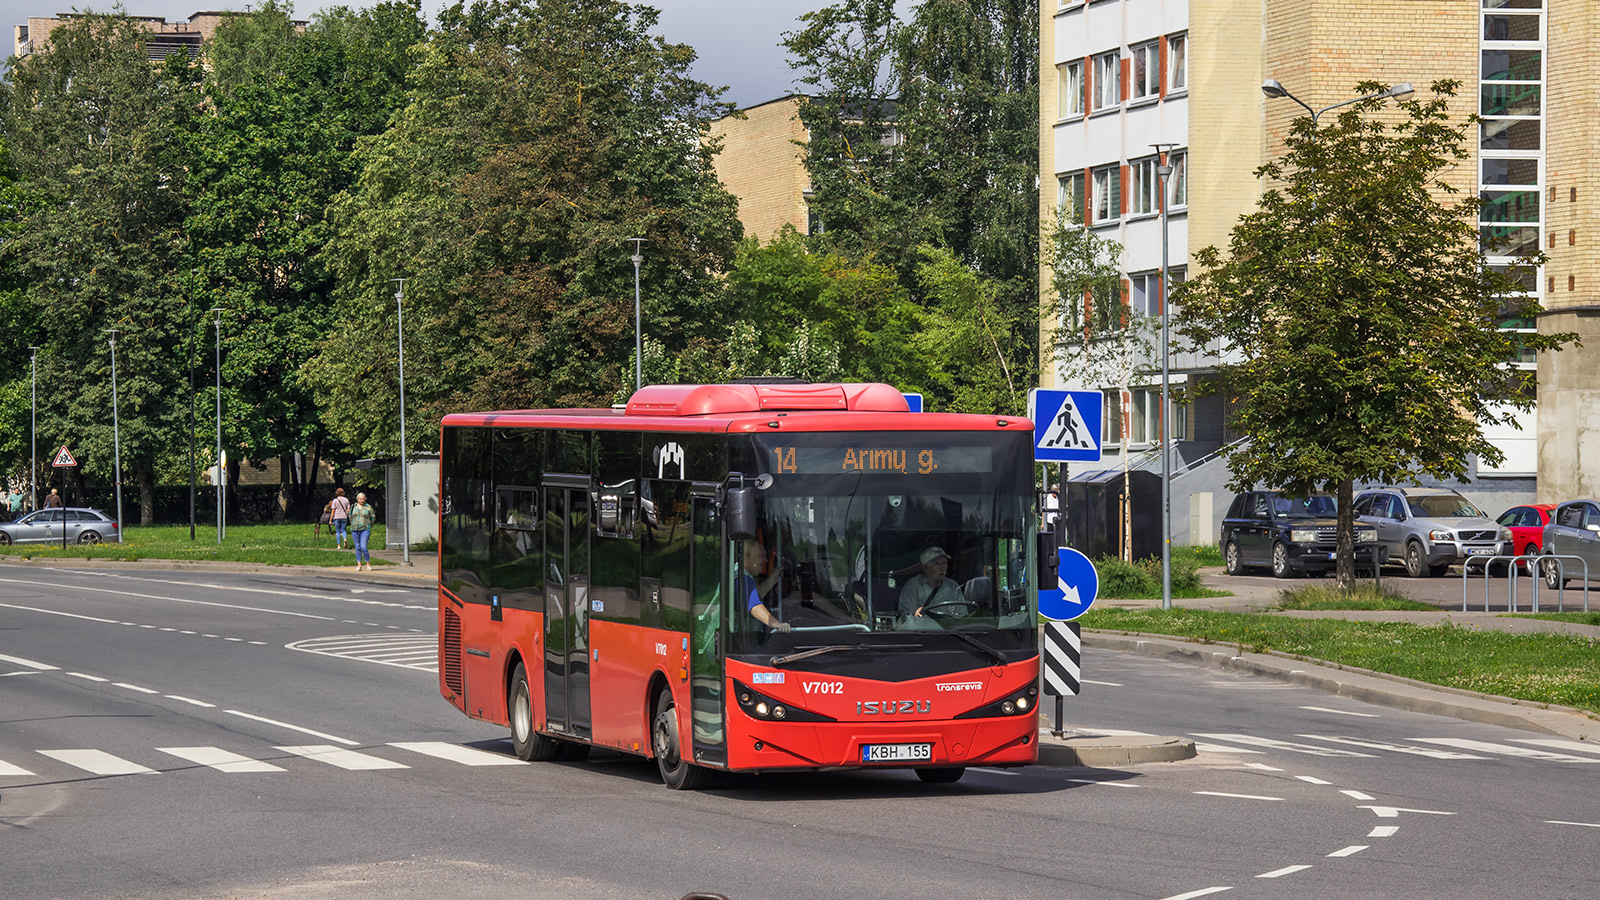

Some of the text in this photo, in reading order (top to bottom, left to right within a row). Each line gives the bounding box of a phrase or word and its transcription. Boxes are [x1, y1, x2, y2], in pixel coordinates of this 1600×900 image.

[774, 447, 798, 474] 14
[918, 449, 938, 475] g.
[655, 642, 668, 656] V7012
[802, 681, 844, 694] V7012
[935, 681, 984, 692] Transrevis
[856, 700, 931, 715] ISUZU
[870, 745, 929, 759] KBH 155
